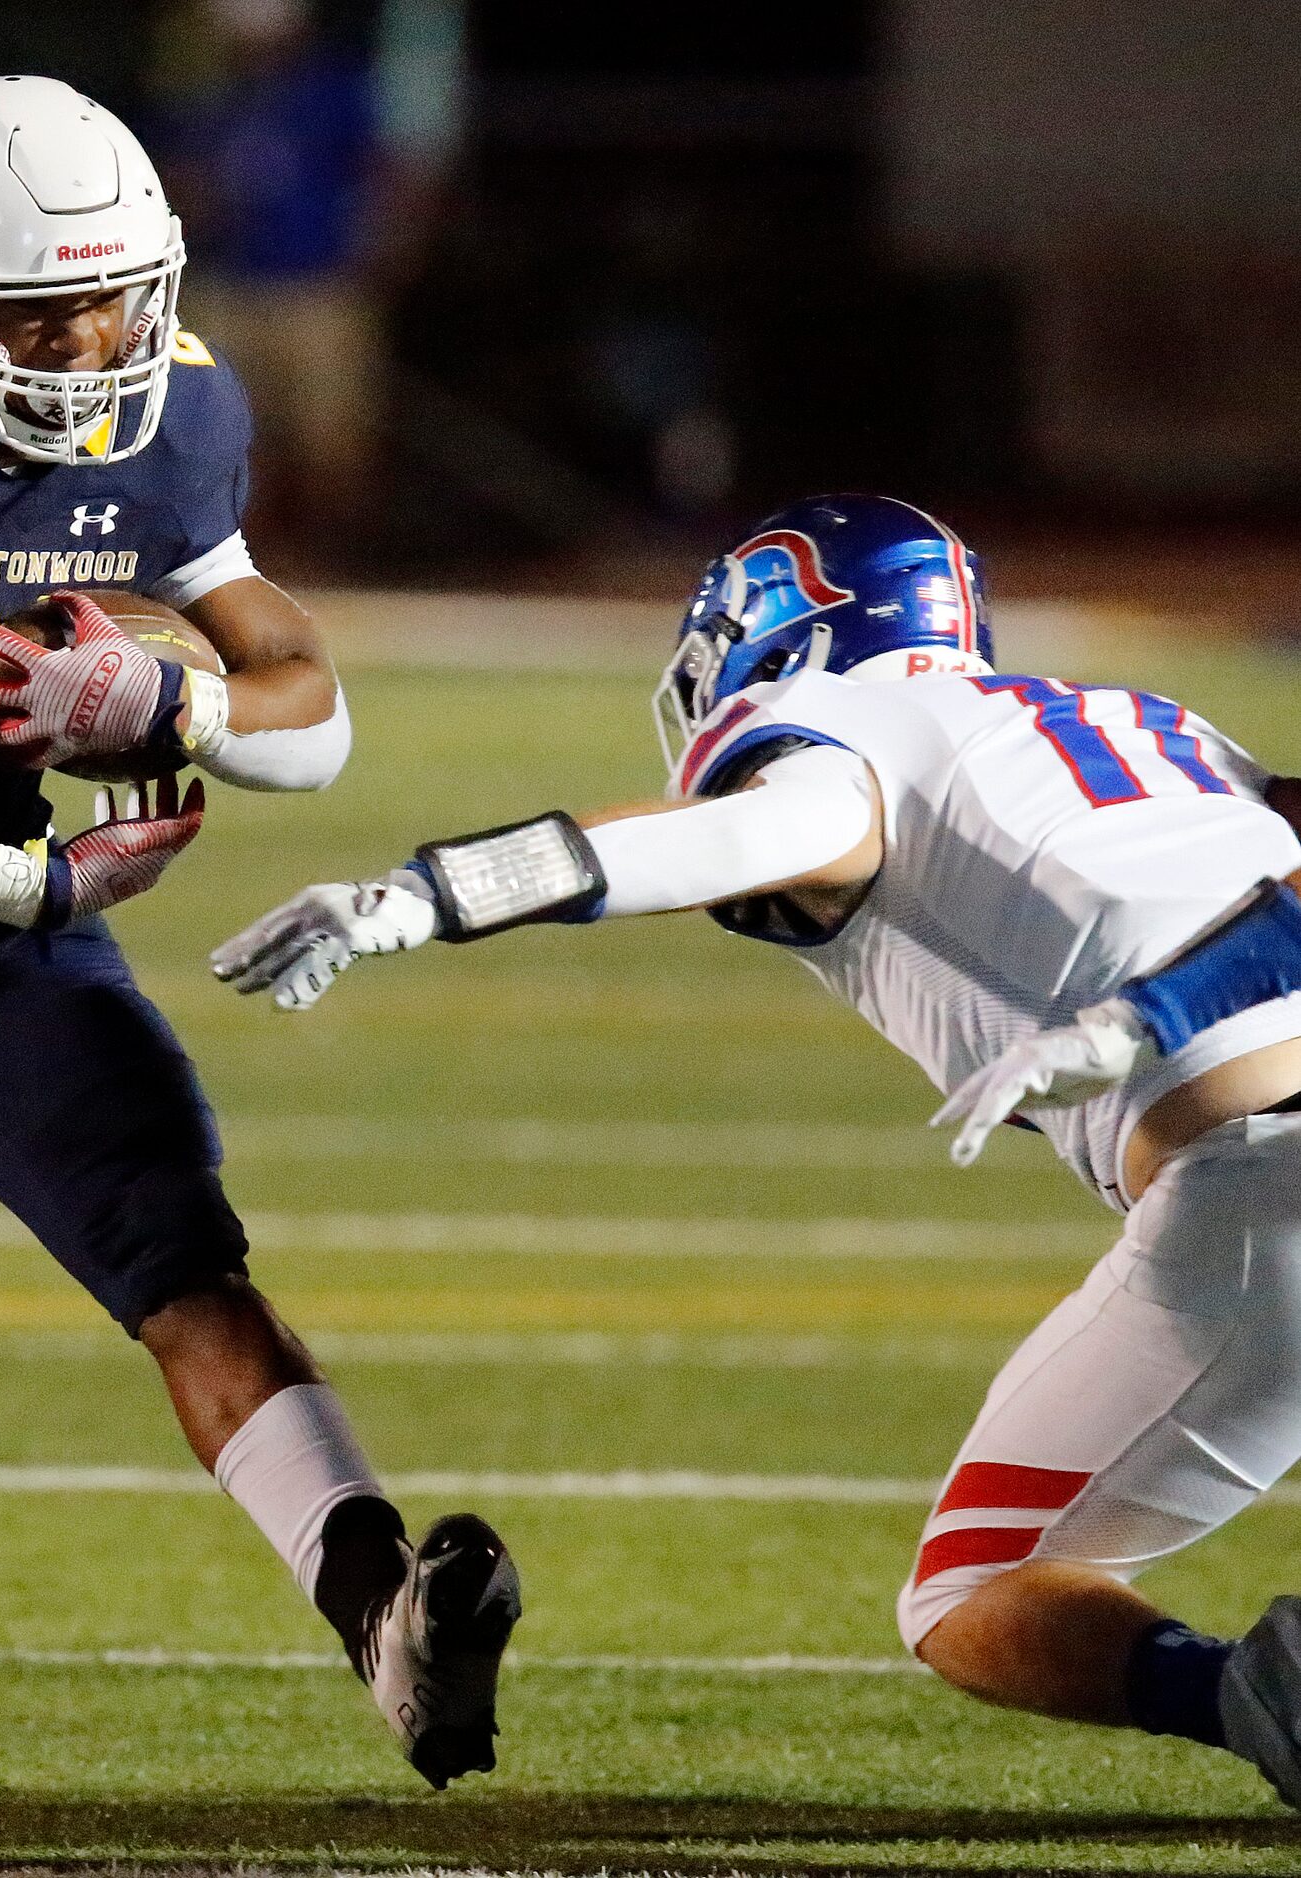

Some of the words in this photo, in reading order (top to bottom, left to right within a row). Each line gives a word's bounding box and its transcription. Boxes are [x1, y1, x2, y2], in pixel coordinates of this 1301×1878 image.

[57, 237, 126, 262] Riddell
[30, 433, 68, 445] Riddell
[69, 658, 118, 740] BATTLE
